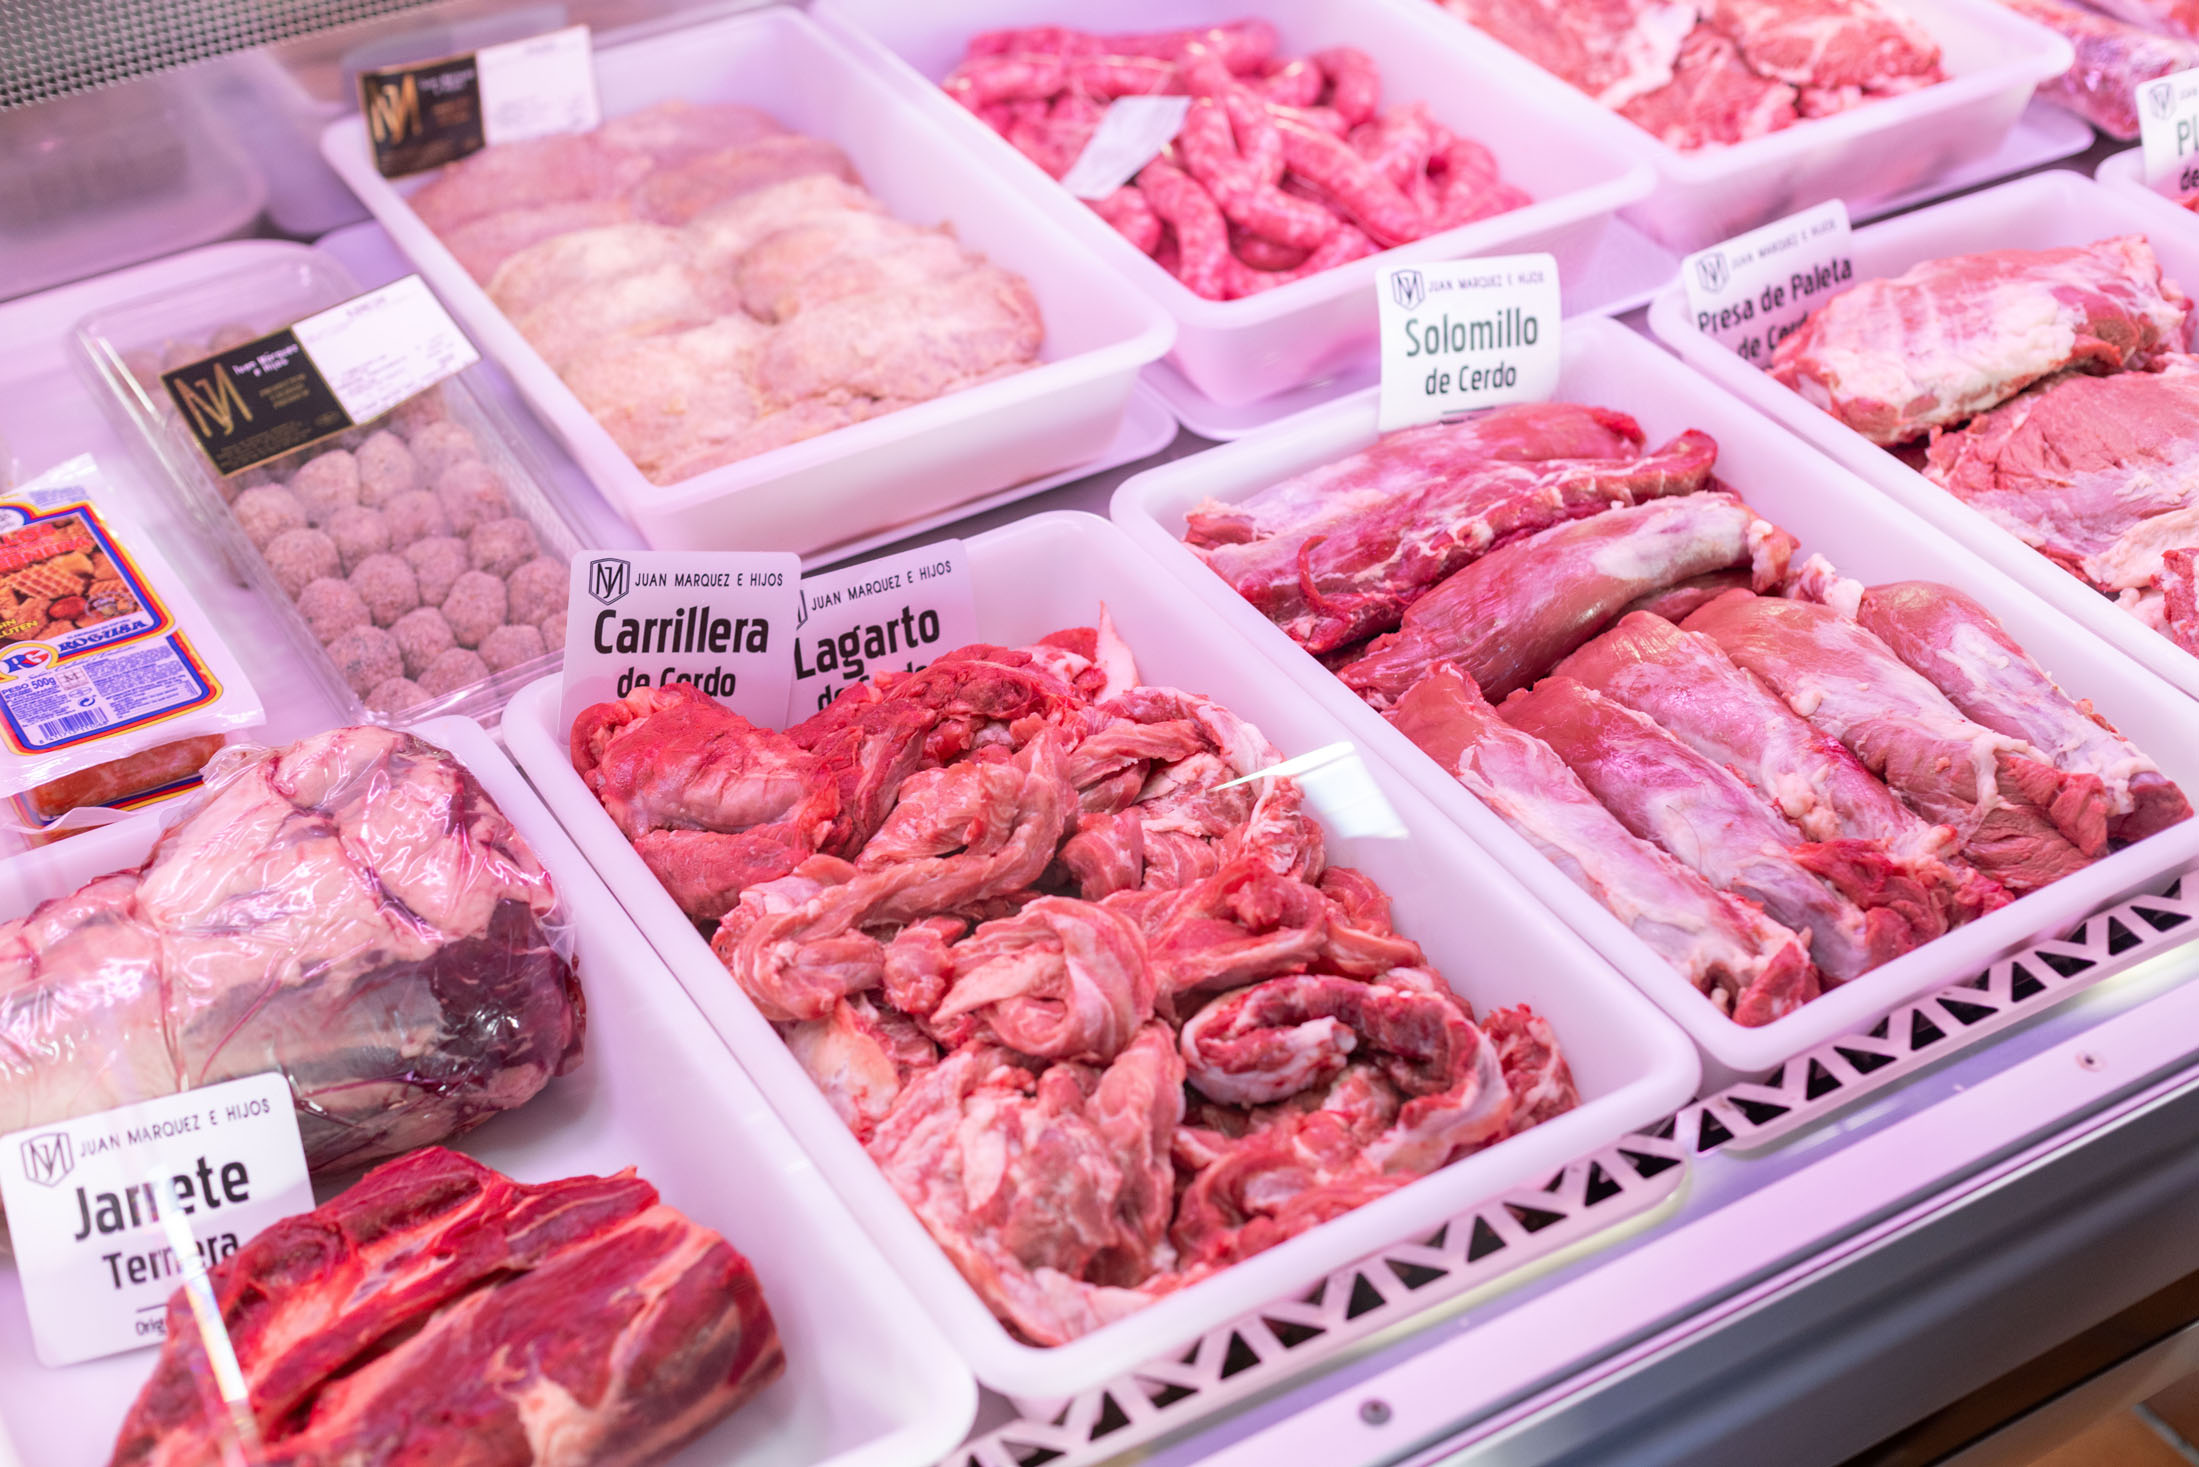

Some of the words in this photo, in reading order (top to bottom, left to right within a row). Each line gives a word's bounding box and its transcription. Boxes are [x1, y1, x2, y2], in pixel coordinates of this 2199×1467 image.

[1698, 300, 1754, 333] Presa
[1760, 285, 1785, 313] de
[1791, 257, 1853, 301] Paleta
[1405, 308, 1537, 357] Solomillo
[1425, 368, 1451, 396] de
[1459, 361, 1517, 393] Cerdo
[635, 573, 667, 587] JUAN
[674, 573, 730, 587] MARQUEZ
[737, 573, 743, 586] E
[750, 573, 783, 587] HIJOS
[811, 591, 842, 611] JUAN
[847, 575, 902, 601] MARQUEZ
[907, 571, 914, 584] E
[919, 560, 952, 581] HIJOS
[58, 620, 147, 652] ROGUSA
[594, 605, 770, 654] Carrillera
[794, 605, 940, 681] Lagarto
[31, 677, 57, 690] 500g
[617, 666, 651, 699] de
[79, 1133, 121, 1157] JUAN
[126, 1114, 201, 1145] MARQUEZ
[209, 1110, 218, 1125] E
[226, 1098, 271, 1122] HIJOS
